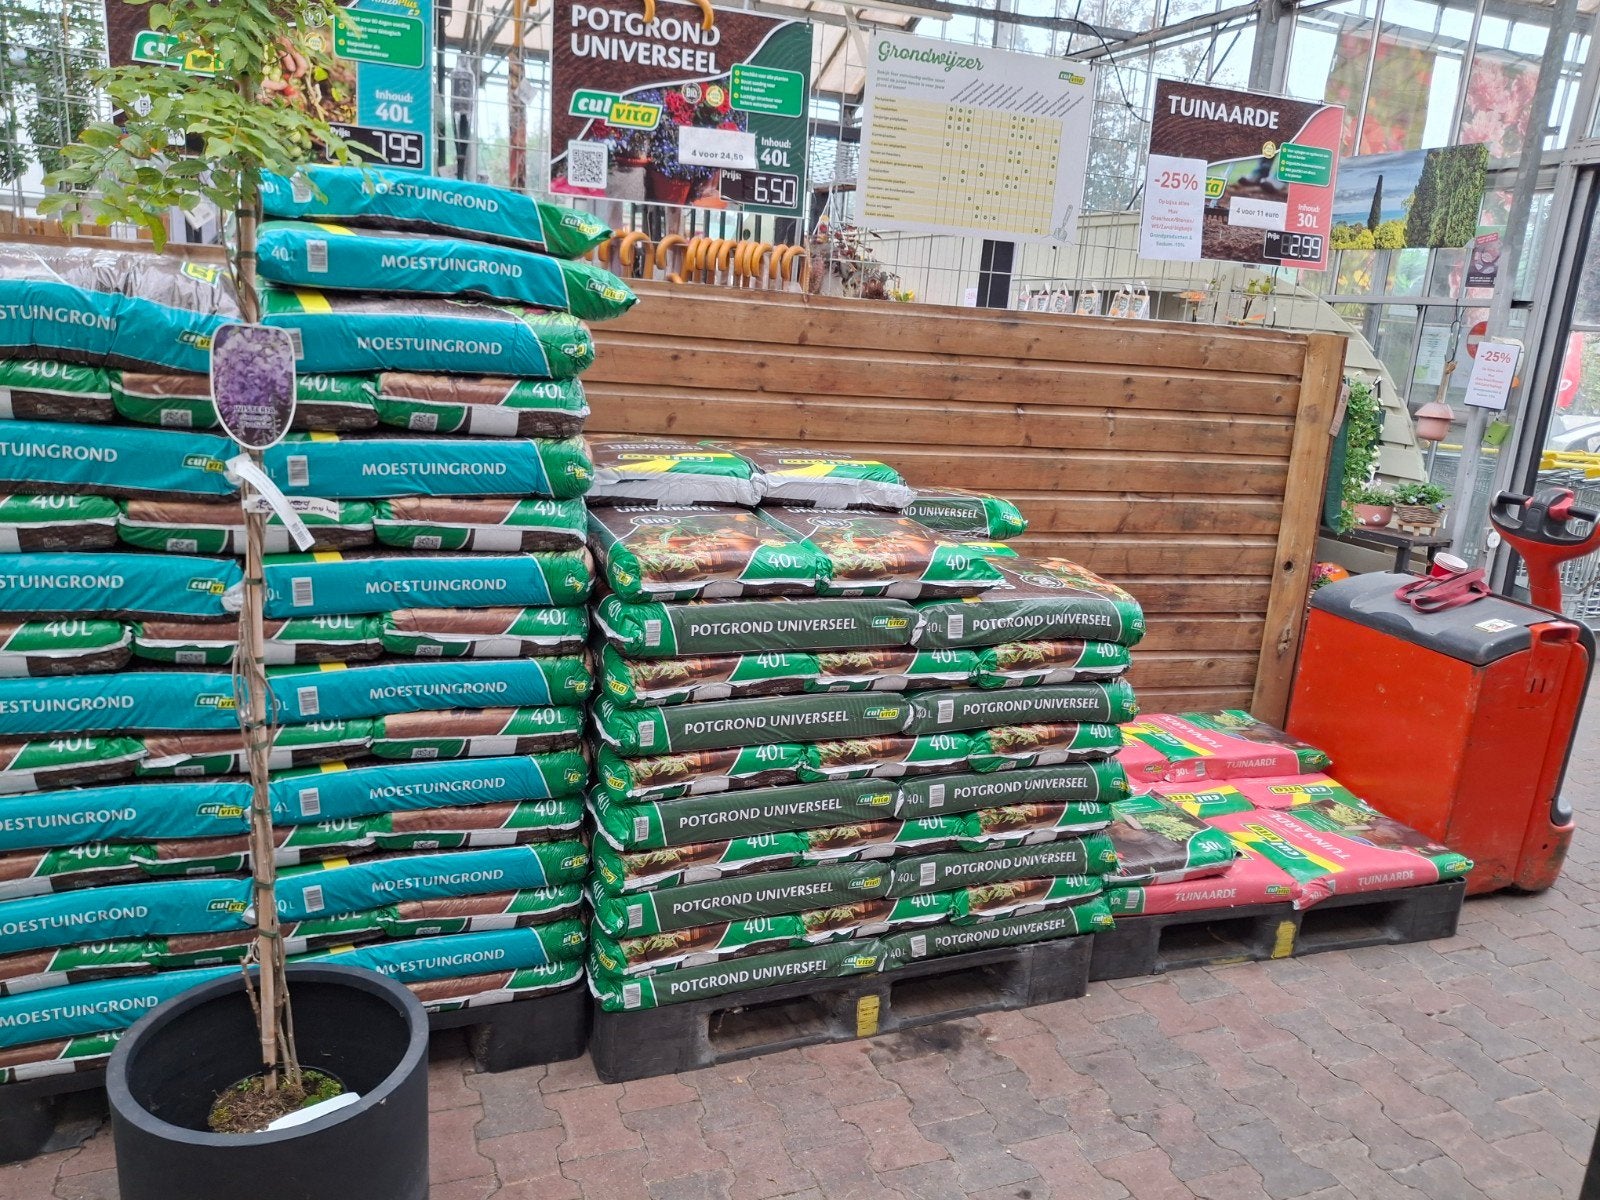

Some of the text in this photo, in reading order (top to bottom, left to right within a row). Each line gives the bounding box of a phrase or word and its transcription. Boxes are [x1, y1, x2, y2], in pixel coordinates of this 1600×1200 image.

[571, 5, 720, 46] POTGROND
[571, 32, 721, 74] UNIVERSEEL
[878, 40, 984, 73] Grondwijzer
[375, 89, 413, 103] Inhoud:
[375, 102, 413, 124] 40L
[1168, 94, 1279, 130] TUINAARDE
[761, 136, 792, 149] Inhoud:
[691, 150, 698, 158] 4
[719, 151, 744, 161] 24,50
[760, 147, 791, 167] 40L
[722, 170, 742, 182] Prijs:
[1154, 171, 1198, 190] -25%
[361, 174, 499, 213] MOESTUINGROND
[1241, 209, 1255, 217] voor
[1297, 213, 1320, 229] 30L
[380, 254, 523, 279] MOESTUINGROND
[356, 335, 503, 356] MOESTUINGROND
[1481, 350, 1512, 364] -25%
[299, 376, 343, 394] 40L
[532, 384, 566, 400] 40L
[361, 461, 507, 477] MOESTUINGROND
[533, 501, 567, 518] 40L
[919, 506, 978, 519] UNIVERSEEL
[768, 554, 801, 569] 40L
[945, 555, 971, 571] 40L
[365, 578, 507, 595] MOESTUINGROND
[537, 609, 569, 626] 40L
[972, 613, 1112, 631] POTGROND UNIVERSEEL
[690, 618, 857, 637] POTGROND UNIVERSEEL
[931, 649, 961, 664] 40L
[1096, 642, 1121, 658] 40L
[757, 652, 790, 669] 40L
[369, 680, 508, 700] MOESTUINGROND
[963, 697, 1100, 715] POTGROND UNIVERSEEL
[531, 708, 566, 725] 40L
[684, 711, 850, 735] POTGROND UNIVERSEEL
[1090, 724, 1115, 739] 40L
[929, 734, 958, 751] 40L
[756, 744, 788, 761] 40L
[1175, 768, 1189, 776] 30L
[1226, 757, 1278, 769] TUINAARDE
[369, 776, 506, 800] MOESTUINGROND
[953, 777, 1089, 799] POTGROND UNIVERSEEL
[532, 799, 567, 817] 40L
[679, 798, 843, 829] POTGROND UNIVERSEEL
[1270, 812, 1350, 859] TUINAARDE
[1197, 840, 1226, 853] 30L
[944, 850, 1078, 877] POTGROND UNIVERSEEL
[371, 869, 504, 894] MOESTUINGROND
[1357, 870, 1415, 886] TUINAARDE
[672, 881, 834, 915] POTGROND UNIVERSEEL
[1175, 888, 1237, 901] TUINAARDE
[935, 918, 1066, 948] POTGROND UNIVERSEEL
[375, 948, 505, 976] MOESTUINGROND
[670, 960, 828, 995] POTGROND UNIVERSEEL
[0, 995, 159, 1028] MOESTUINGROND
